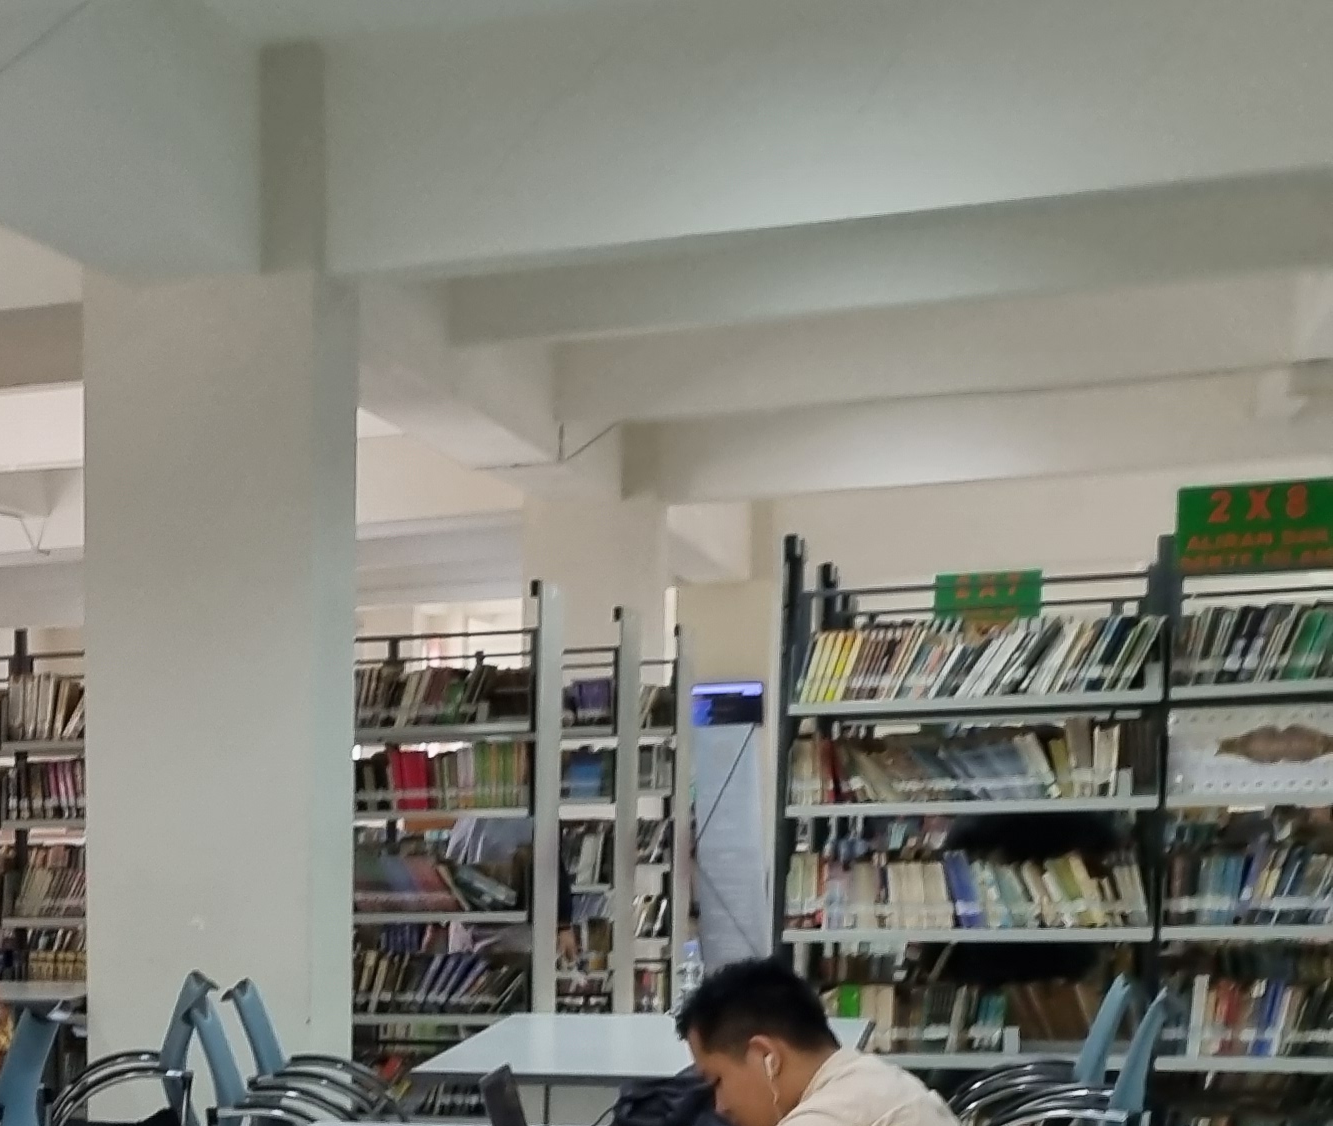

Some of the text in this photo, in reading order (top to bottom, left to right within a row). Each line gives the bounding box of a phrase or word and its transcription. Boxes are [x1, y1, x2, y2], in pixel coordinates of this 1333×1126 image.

[1208, 484, 1308, 523] 2 X 8
